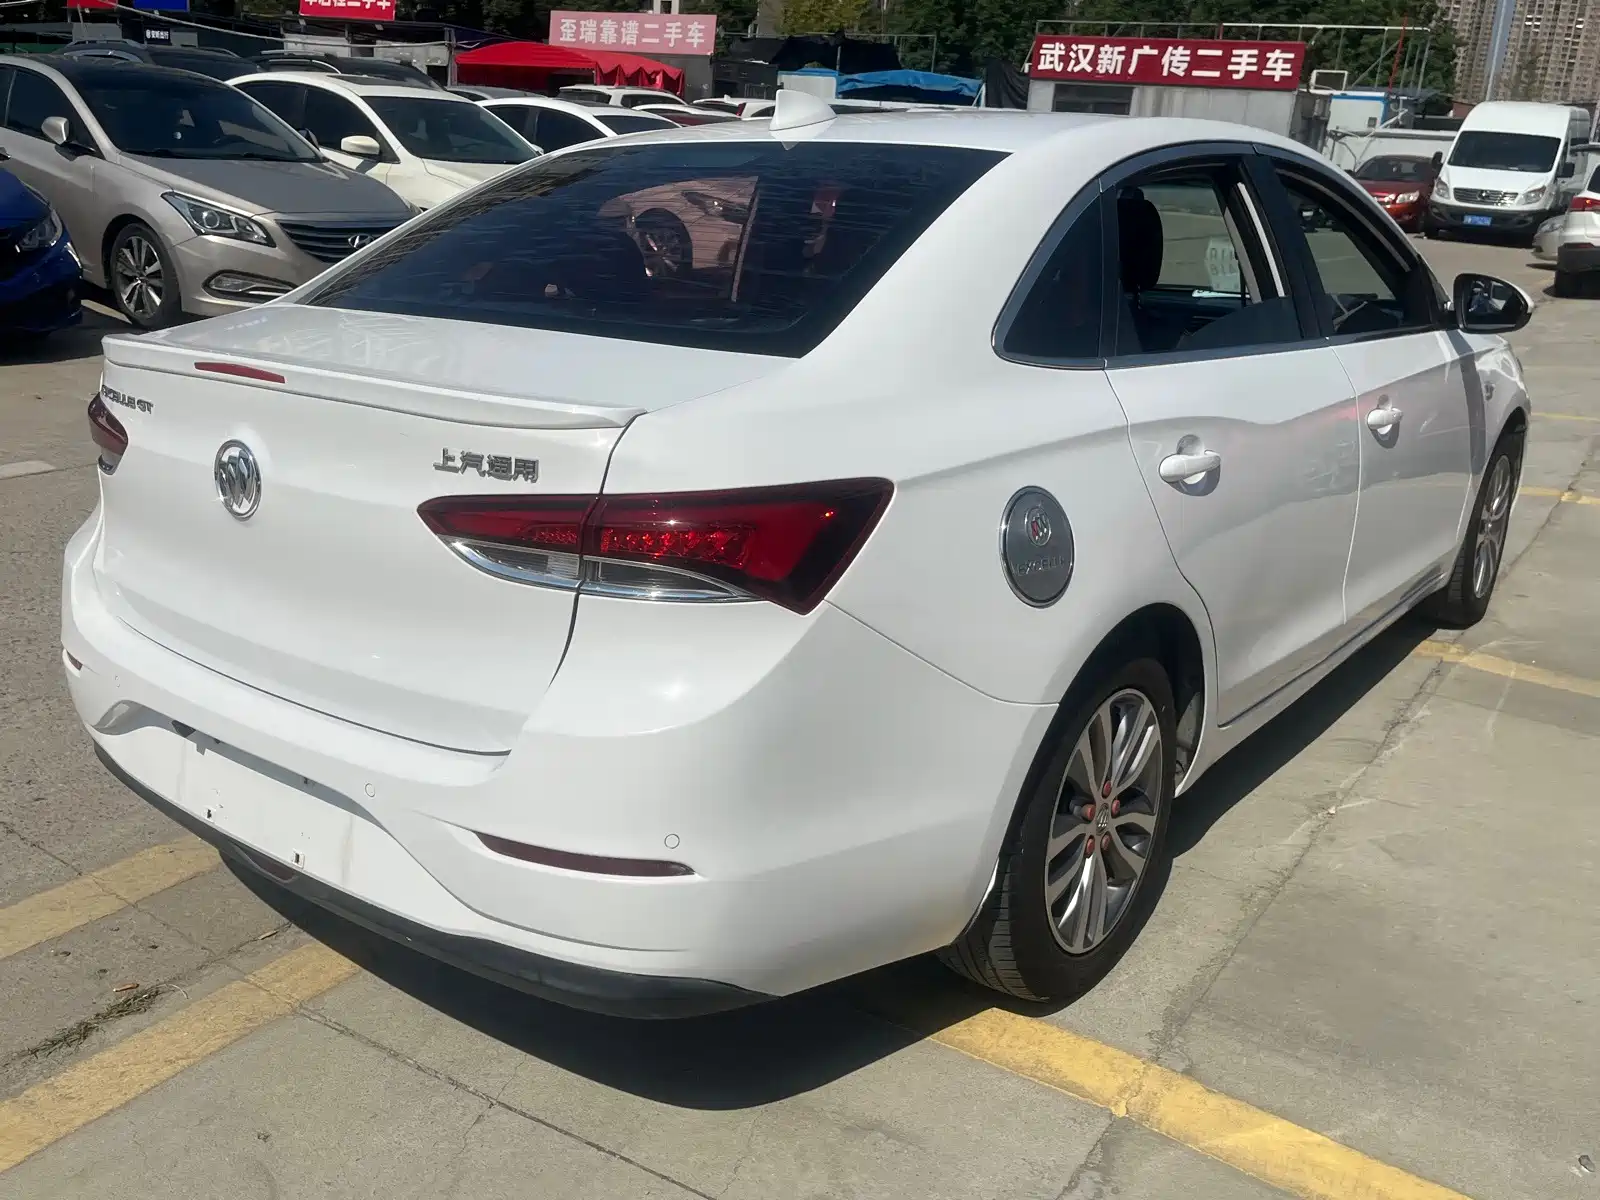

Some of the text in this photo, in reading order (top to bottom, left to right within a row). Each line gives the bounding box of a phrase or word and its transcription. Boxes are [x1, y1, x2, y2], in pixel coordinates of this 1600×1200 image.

[559, 18, 705, 48] 歪瑞靠谱二手车
[1037, 42, 1296, 82] 武汉新广传二手车
[137, 399, 154, 414] GT
[432, 447, 540, 484] 上汽通用
